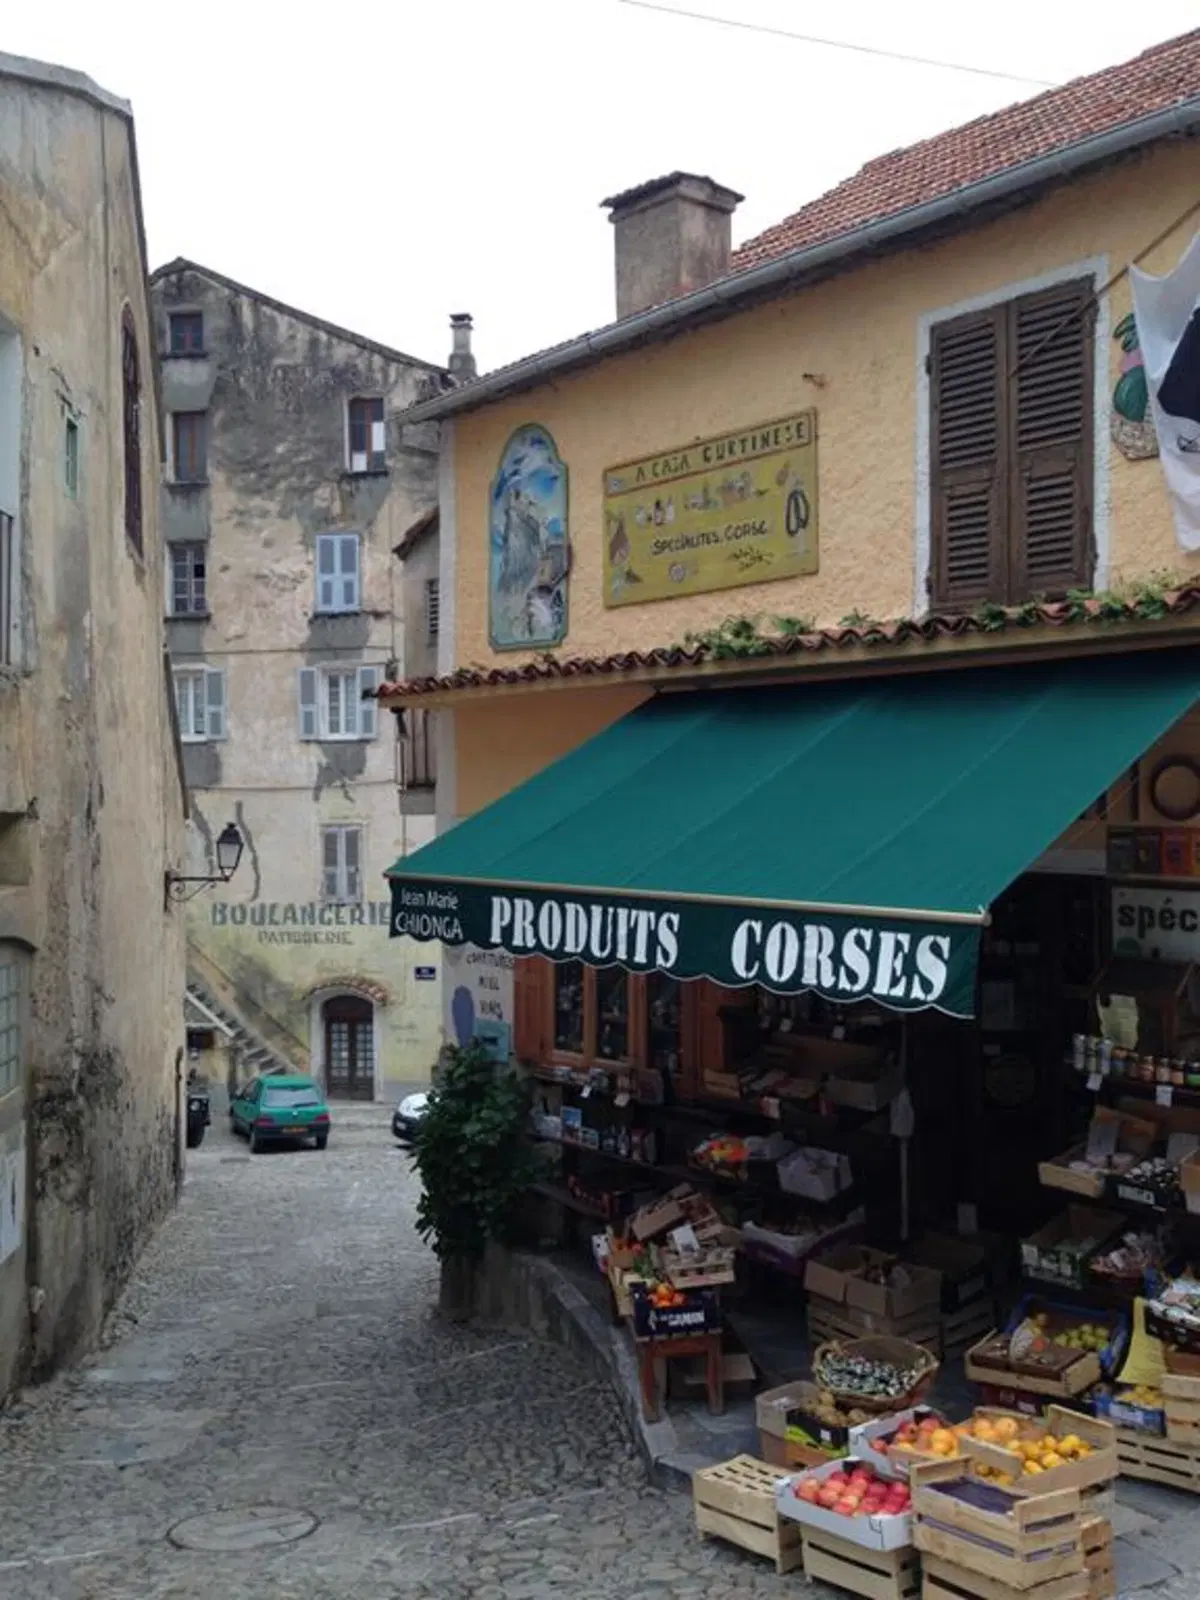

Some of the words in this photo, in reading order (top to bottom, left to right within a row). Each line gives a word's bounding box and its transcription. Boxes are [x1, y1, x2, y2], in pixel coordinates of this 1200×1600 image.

[427, 890, 459, 910] Marie
[395, 911, 464, 941] CHIONGA
[490, 896, 680, 969] PRODUITS
[730, 918, 951, 1002] CORSES
